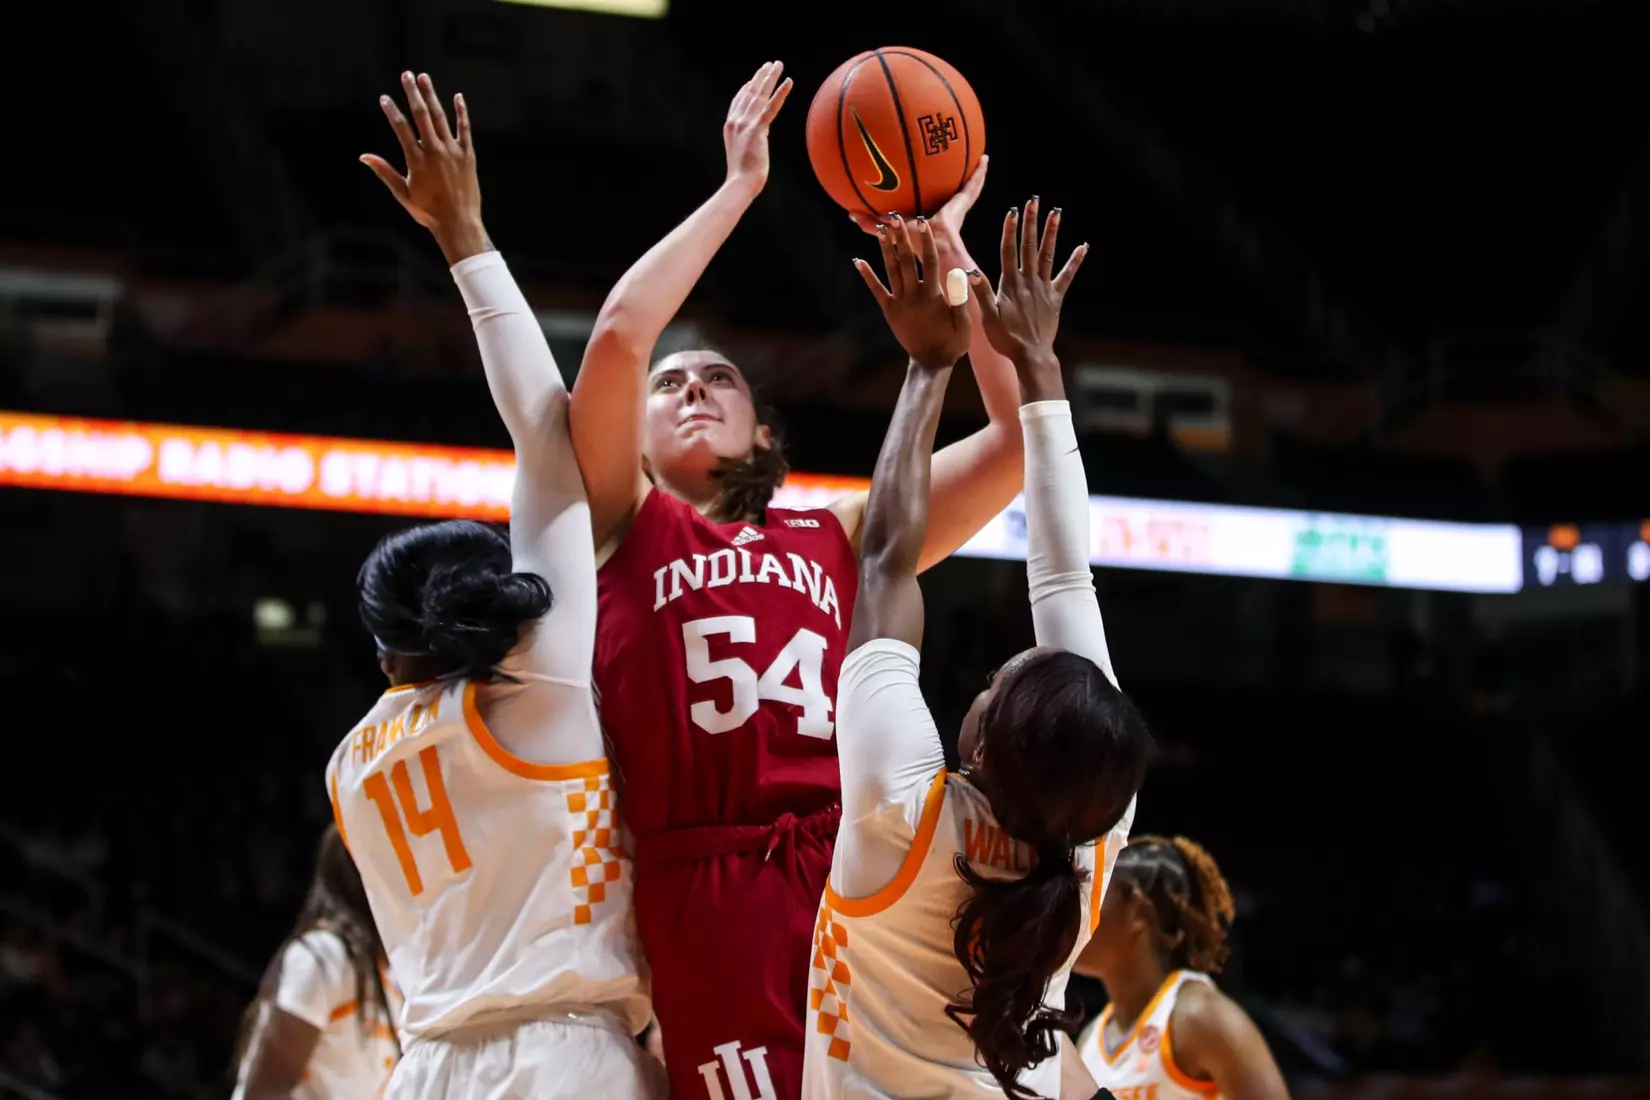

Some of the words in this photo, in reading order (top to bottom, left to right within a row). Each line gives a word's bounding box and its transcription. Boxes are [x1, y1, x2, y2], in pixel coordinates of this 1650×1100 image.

[653, 547, 842, 631] INDIANA
[682, 615, 834, 740] 54
[363, 744, 473, 897] 14
[964, 818, 1038, 872] WAL
